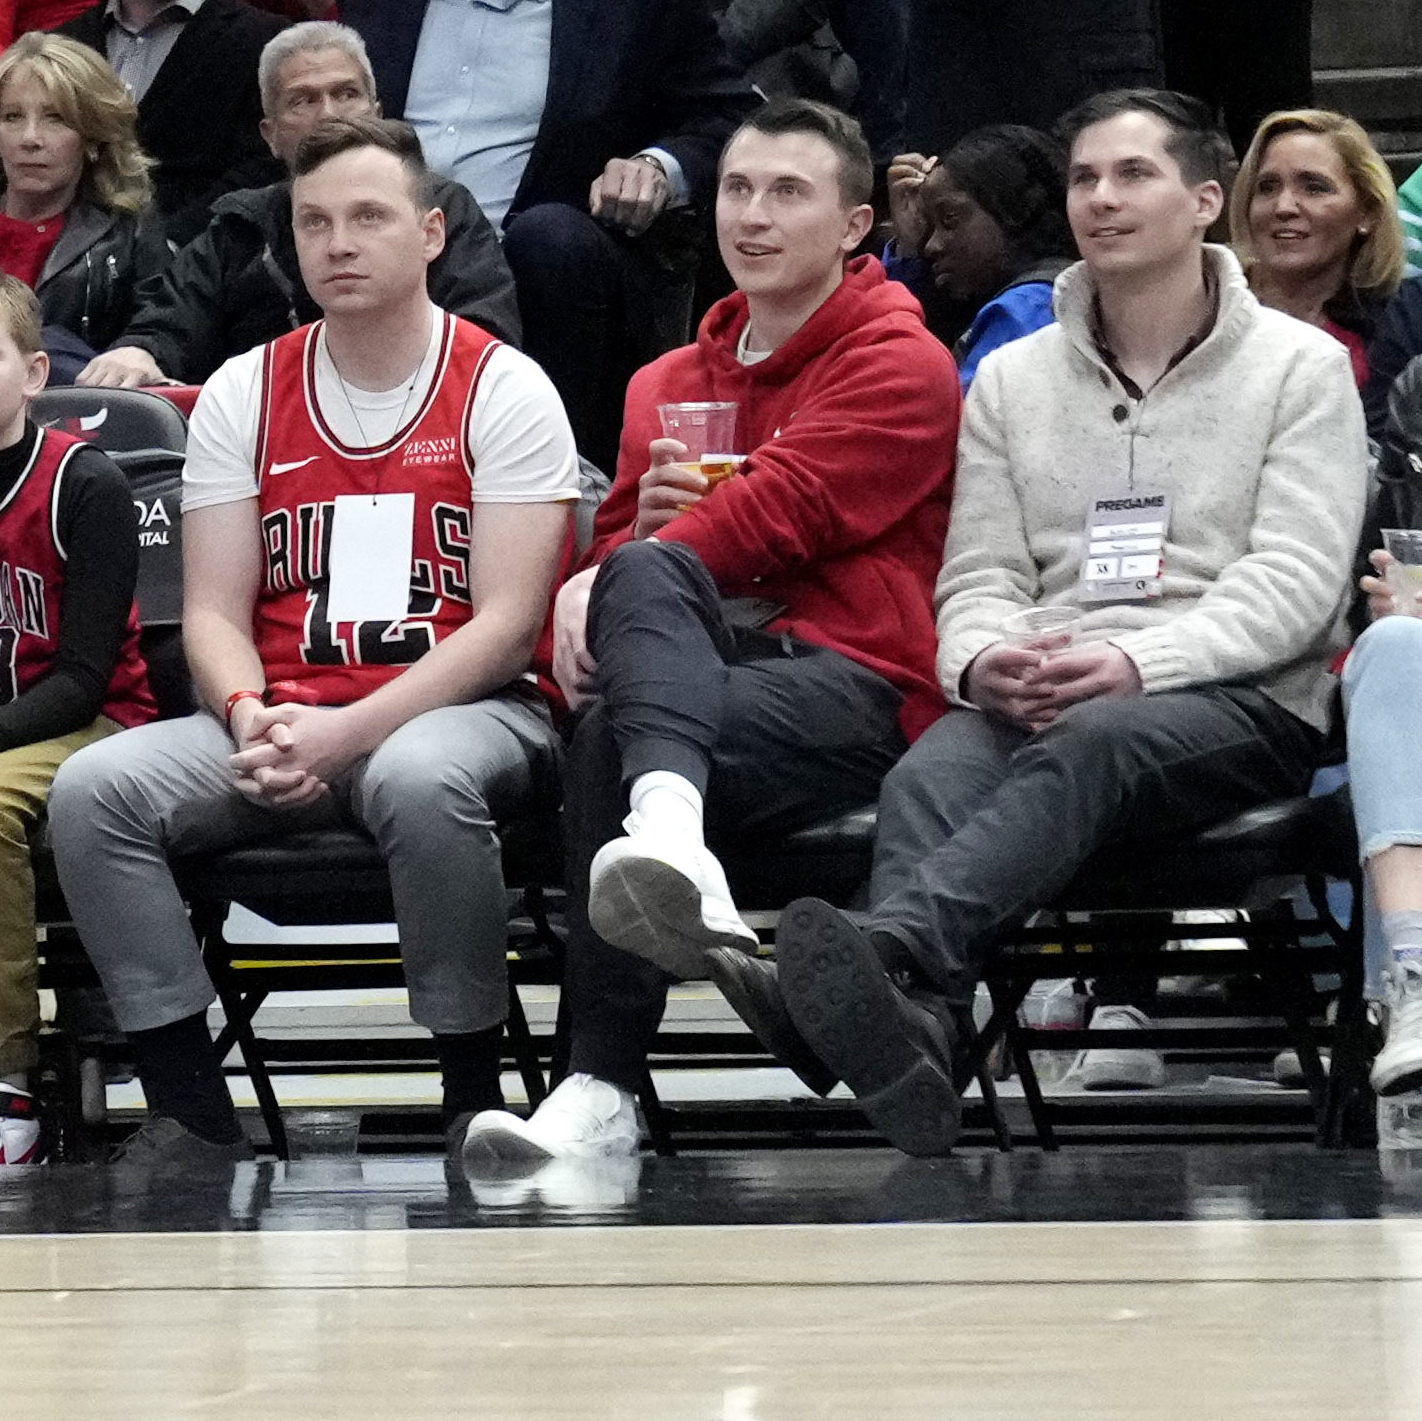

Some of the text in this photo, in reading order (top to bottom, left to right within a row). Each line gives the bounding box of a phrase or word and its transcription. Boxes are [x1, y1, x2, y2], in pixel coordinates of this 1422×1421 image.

[404, 437, 456, 456] ZENNI
[402, 452, 456, 467] EYEWEAR
[1095, 495, 1165, 512] PREGAME
